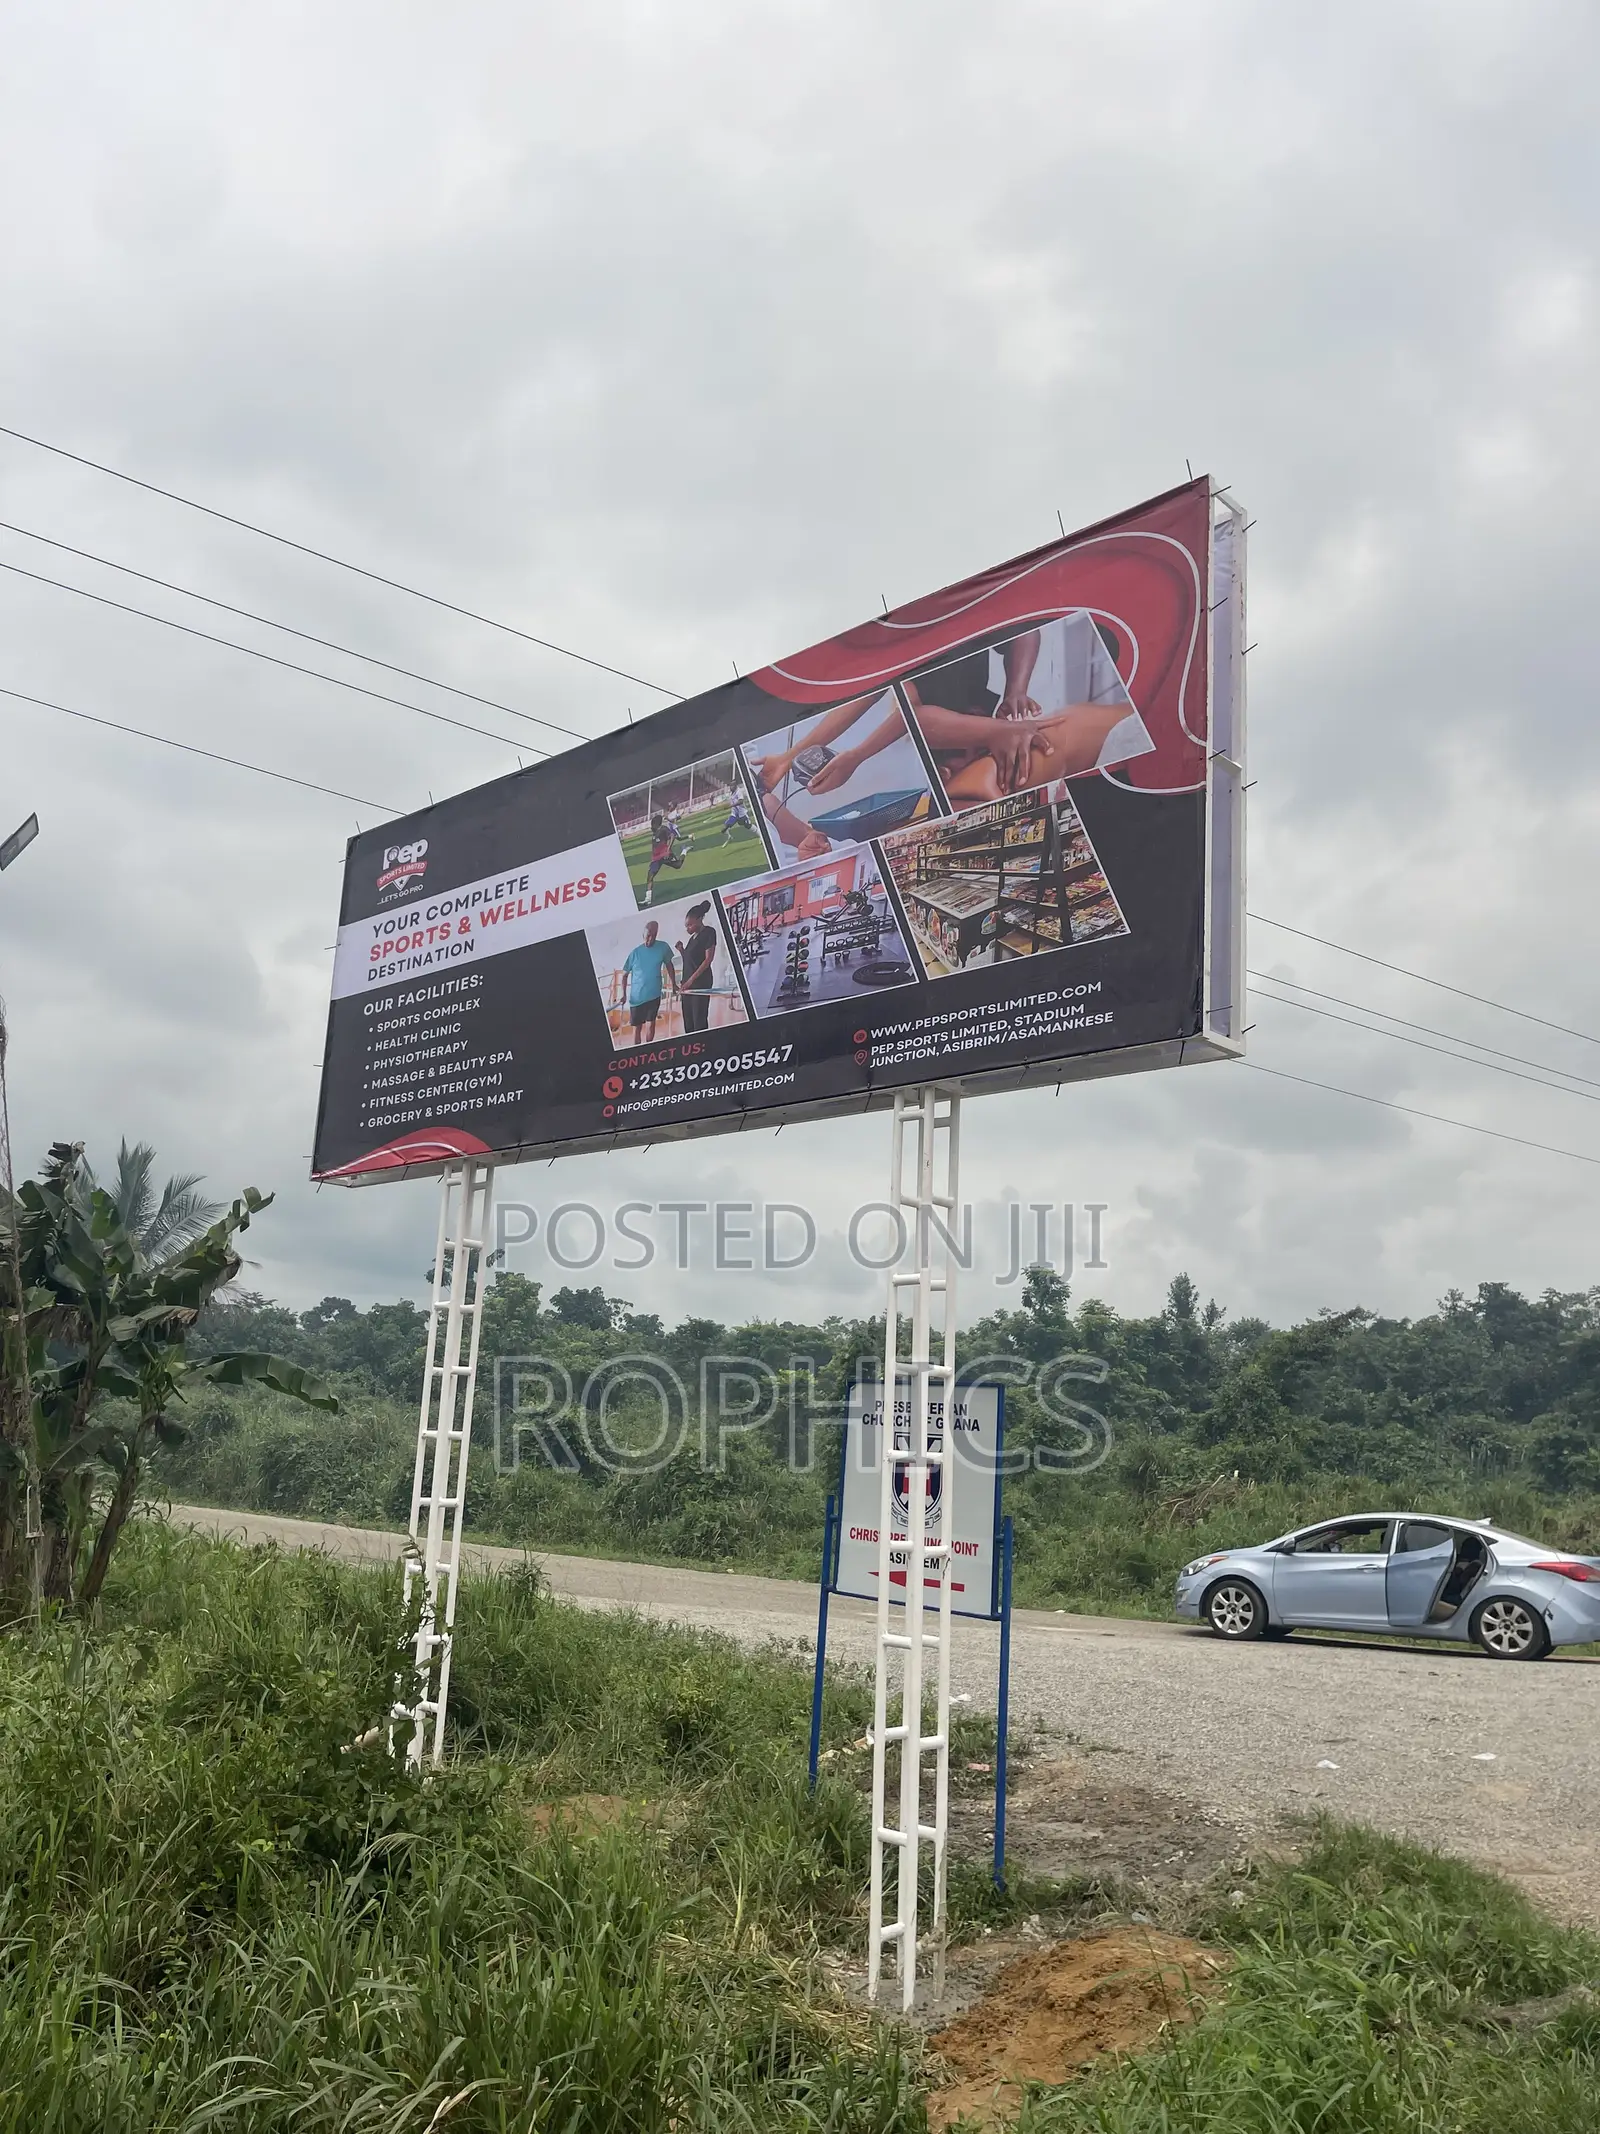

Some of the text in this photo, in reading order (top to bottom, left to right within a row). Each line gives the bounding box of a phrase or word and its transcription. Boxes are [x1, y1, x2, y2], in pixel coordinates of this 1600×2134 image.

[379, 862, 425, 884] SPORTS LIMITED
[398, 889, 409, 897] GO
[409, 884, 424, 894] PRO
[369, 872, 607, 962] SPORTS & WELLNESS
[372, 874, 530, 938] YOUR COMPLETE
[368, 939, 475, 982] DESTINATION
[363, 974, 484, 1016] OUR FACILITIES:
[870, 981, 1102, 1039] WWW.PEPSPORTSLIMITED.COM
[377, 998, 481, 1032] SPORTS COMPLEX
[871, 1003, 1085, 1056] PEP SPORTS LIMITED, STADIUM
[373, 1040, 469, 1071] PHYSIOTHERAPY
[375, 1022, 462, 1052] HEALTH CLINIC
[869, 1012, 1114, 1069] JUNCTION, ASIBRIM/ASAMANKESE
[371, 1050, 514, 1090] MASSAGE & BEAUTY SPA
[608, 1042, 706, 1072] CONTACT US:
[629, 1044, 794, 1091] +233302905547
[367, 1090, 523, 1128] GROCERY & SPORTS MART
[369, 1072, 503, 1109] FITNESS CENTER(GYM)
[616, 1073, 795, 1115] INFO@PEPSPORTSLIMITED.COM
[935, 1417, 980, 1432] GANA
[849, 1527, 884, 1543] CHRIS
